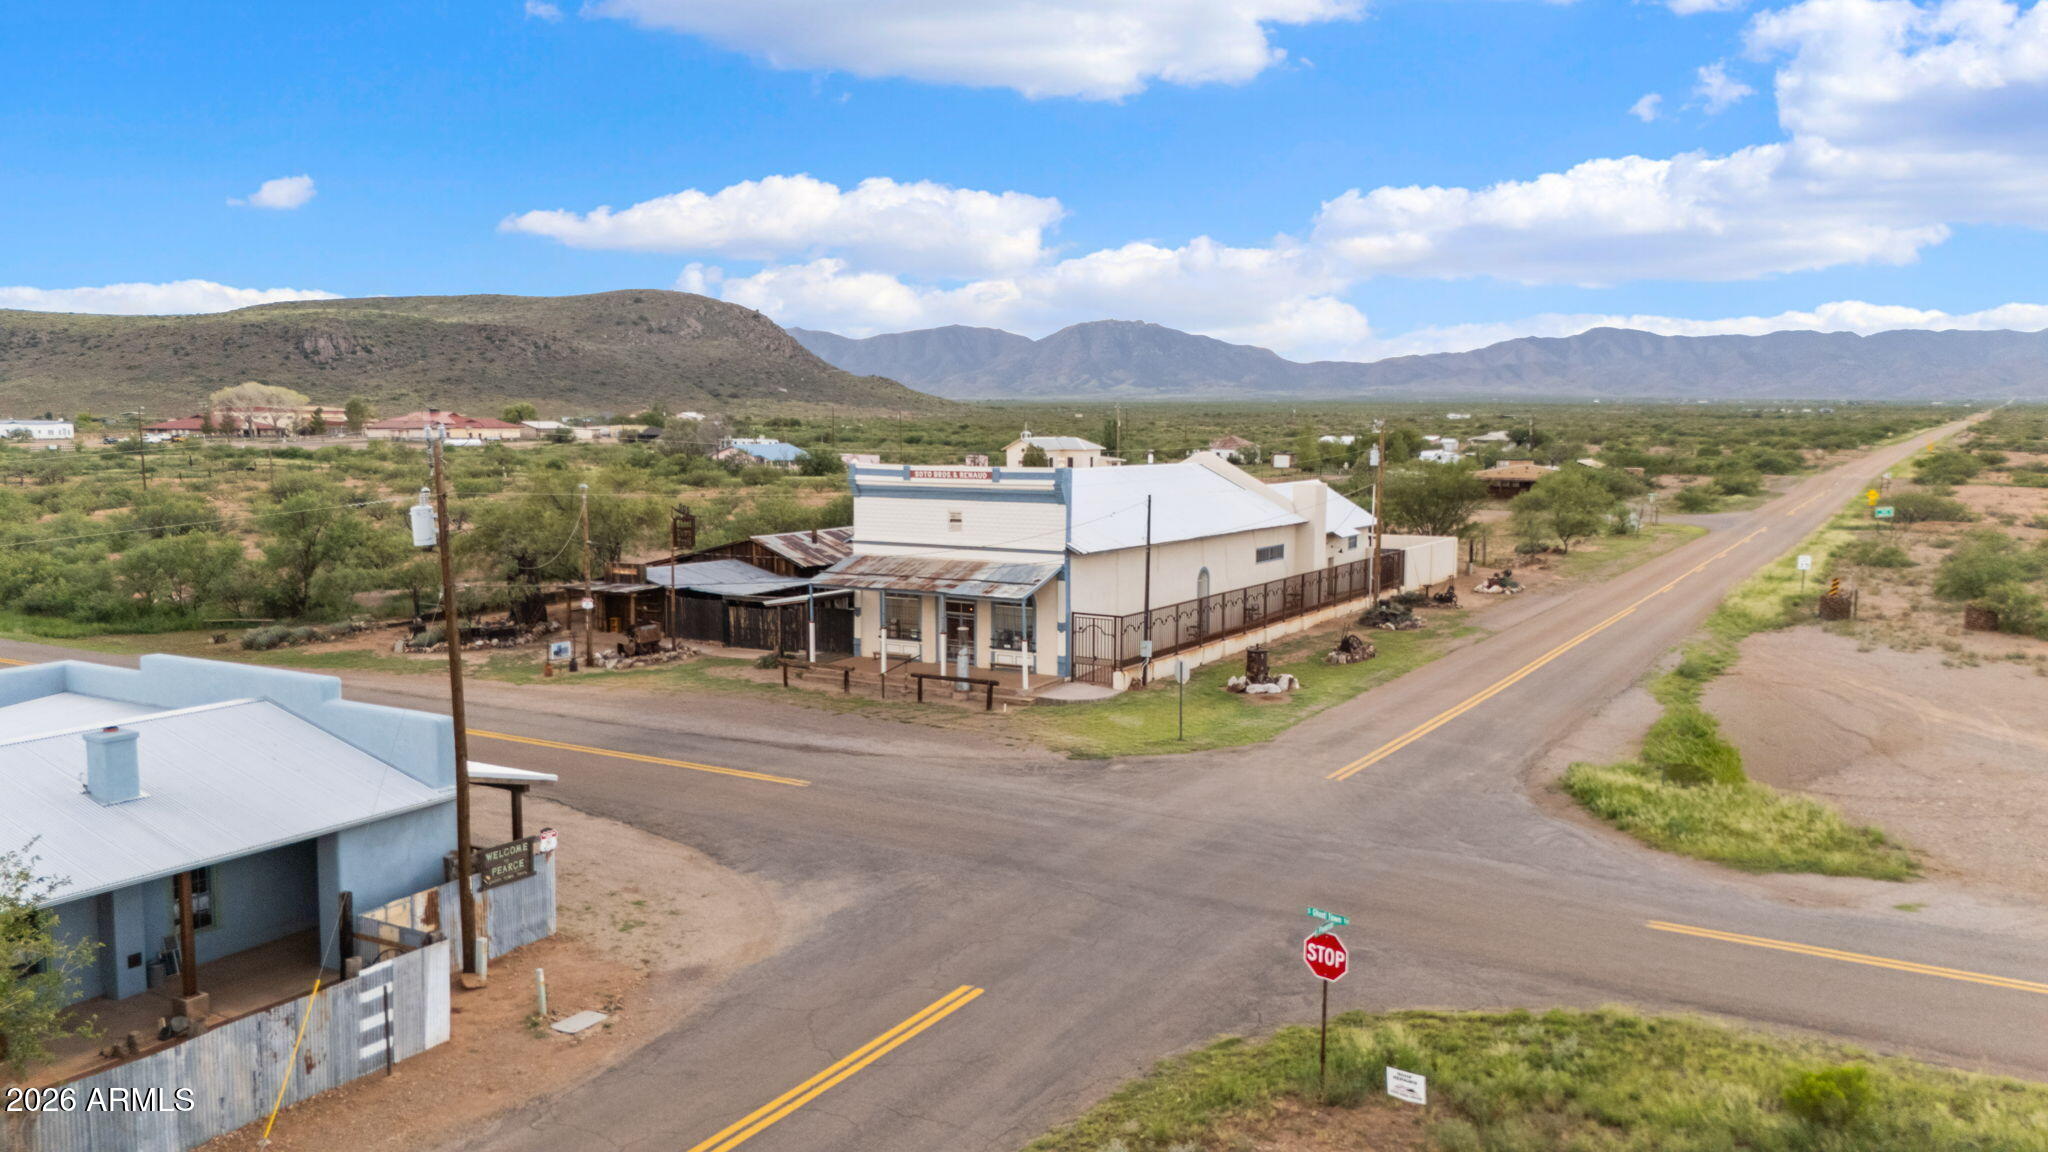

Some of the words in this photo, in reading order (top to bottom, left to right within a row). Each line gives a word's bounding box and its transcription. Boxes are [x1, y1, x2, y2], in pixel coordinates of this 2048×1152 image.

[960, 472, 988, 480] RENAUD
[485, 842, 529, 861] WELCOME
[492, 858, 525, 876] PEARCE
[1307, 943, 1345, 968] STOP
